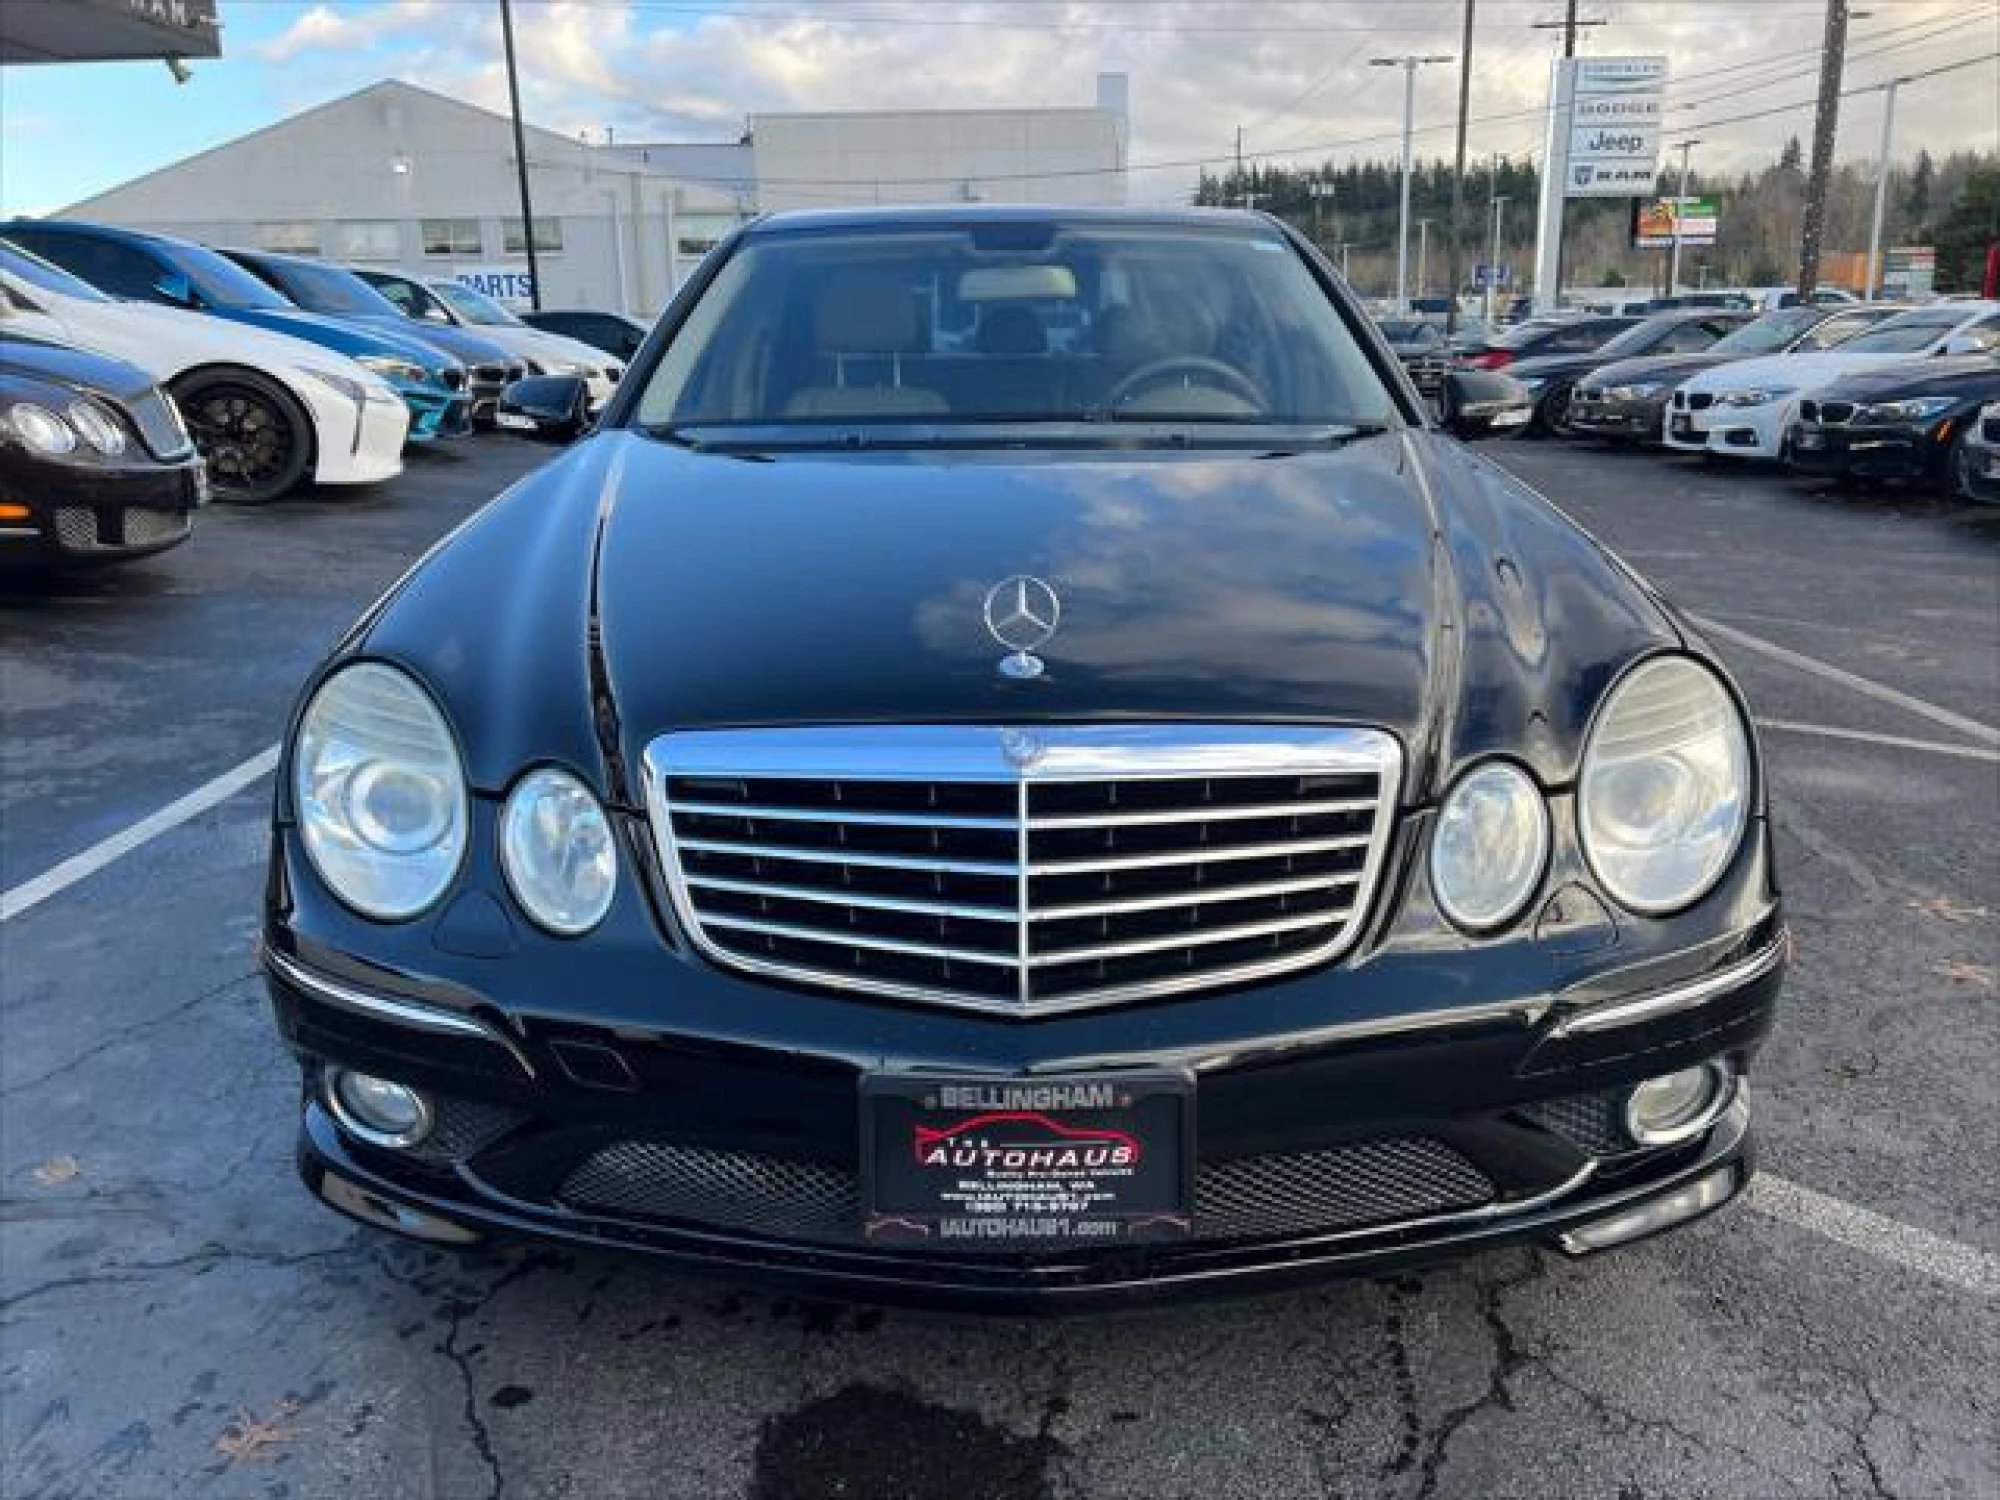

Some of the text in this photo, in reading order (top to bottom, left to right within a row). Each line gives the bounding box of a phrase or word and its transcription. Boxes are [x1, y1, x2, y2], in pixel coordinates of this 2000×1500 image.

[1589, 130, 1644, 153] Jeep
[1596, 171, 1651, 181] RAM
[940, 1083, 1113, 1110] BELLINGHAM
[925, 1146, 1134, 1167] AUTOHAUS
